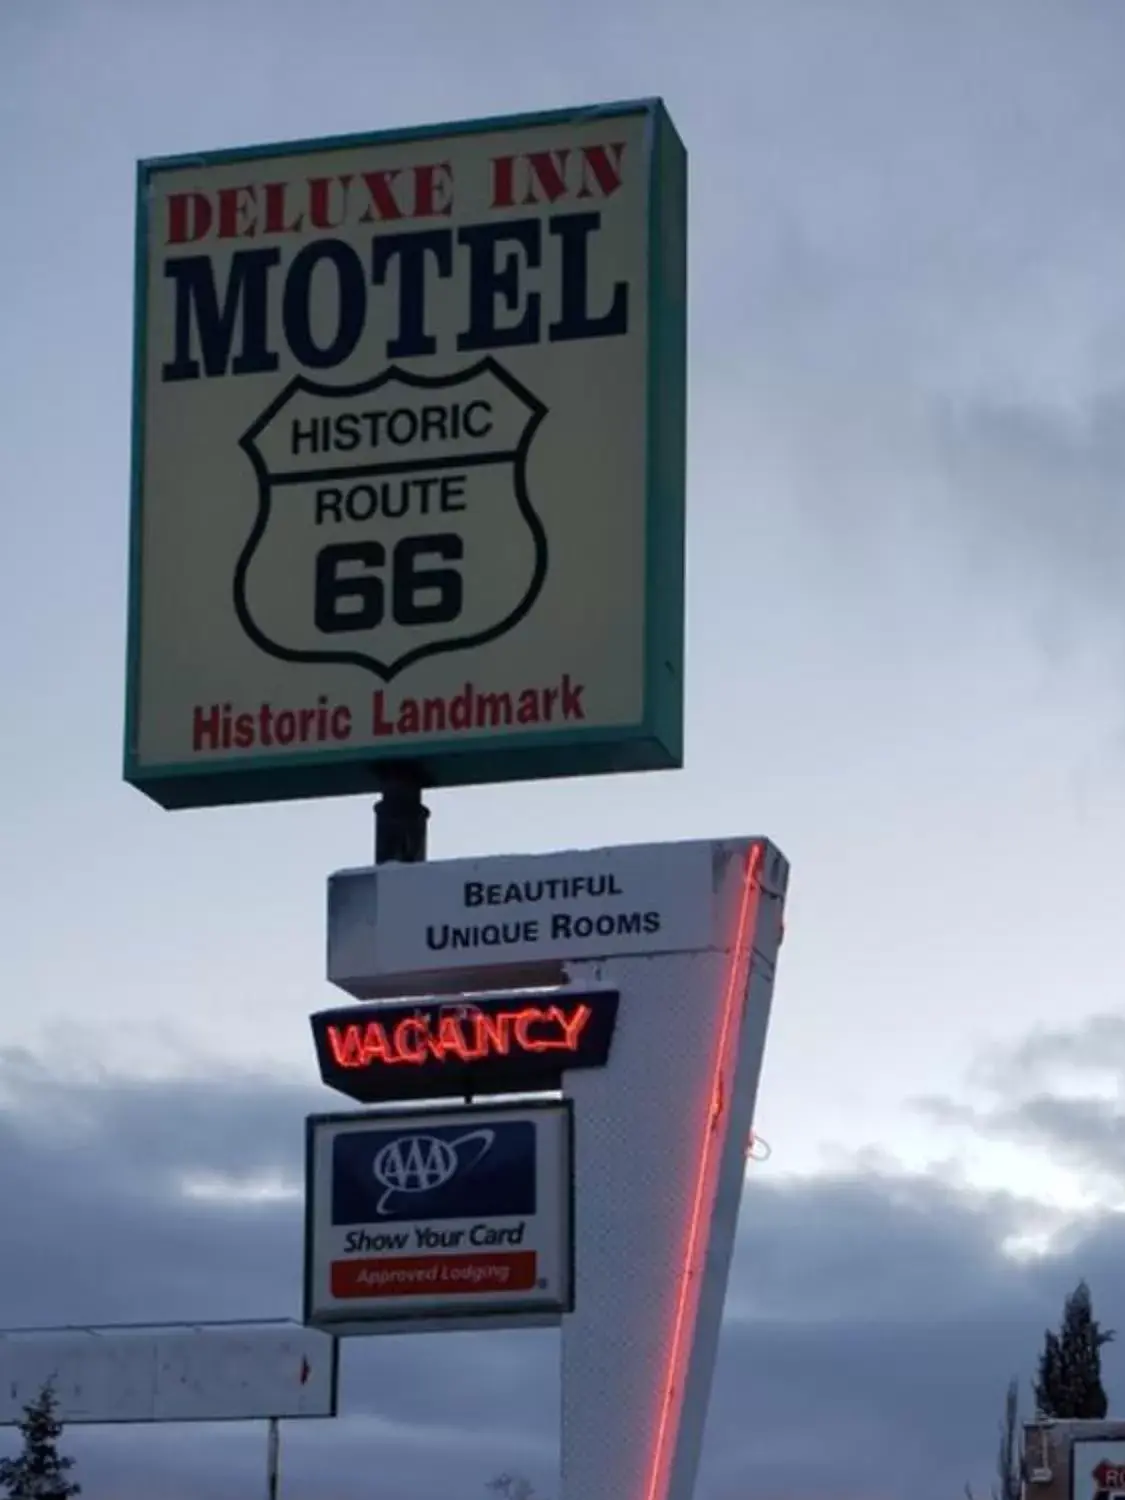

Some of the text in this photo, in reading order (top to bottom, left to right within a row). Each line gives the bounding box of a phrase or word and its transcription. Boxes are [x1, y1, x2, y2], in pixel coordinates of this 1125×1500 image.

[164, 142, 626, 245] DELUXE INN
[162, 211, 628, 382] MOTEL
[291, 400, 493, 454] HISTORIC
[315, 475, 467, 525] ROUTE
[314, 532, 463, 633] 66
[192, 674, 585, 752] Historic Landmark
[463, 873, 623, 908] BEAUTIFUL
[425, 911, 662, 951] UNIQUE ROOMS
[326, 1003, 592, 1069] VACANCY
[384, 1138, 448, 1190] AAA
[344, 1221, 526, 1253] Show Your Card
[355, 1263, 513, 1287] Approved Lodging
